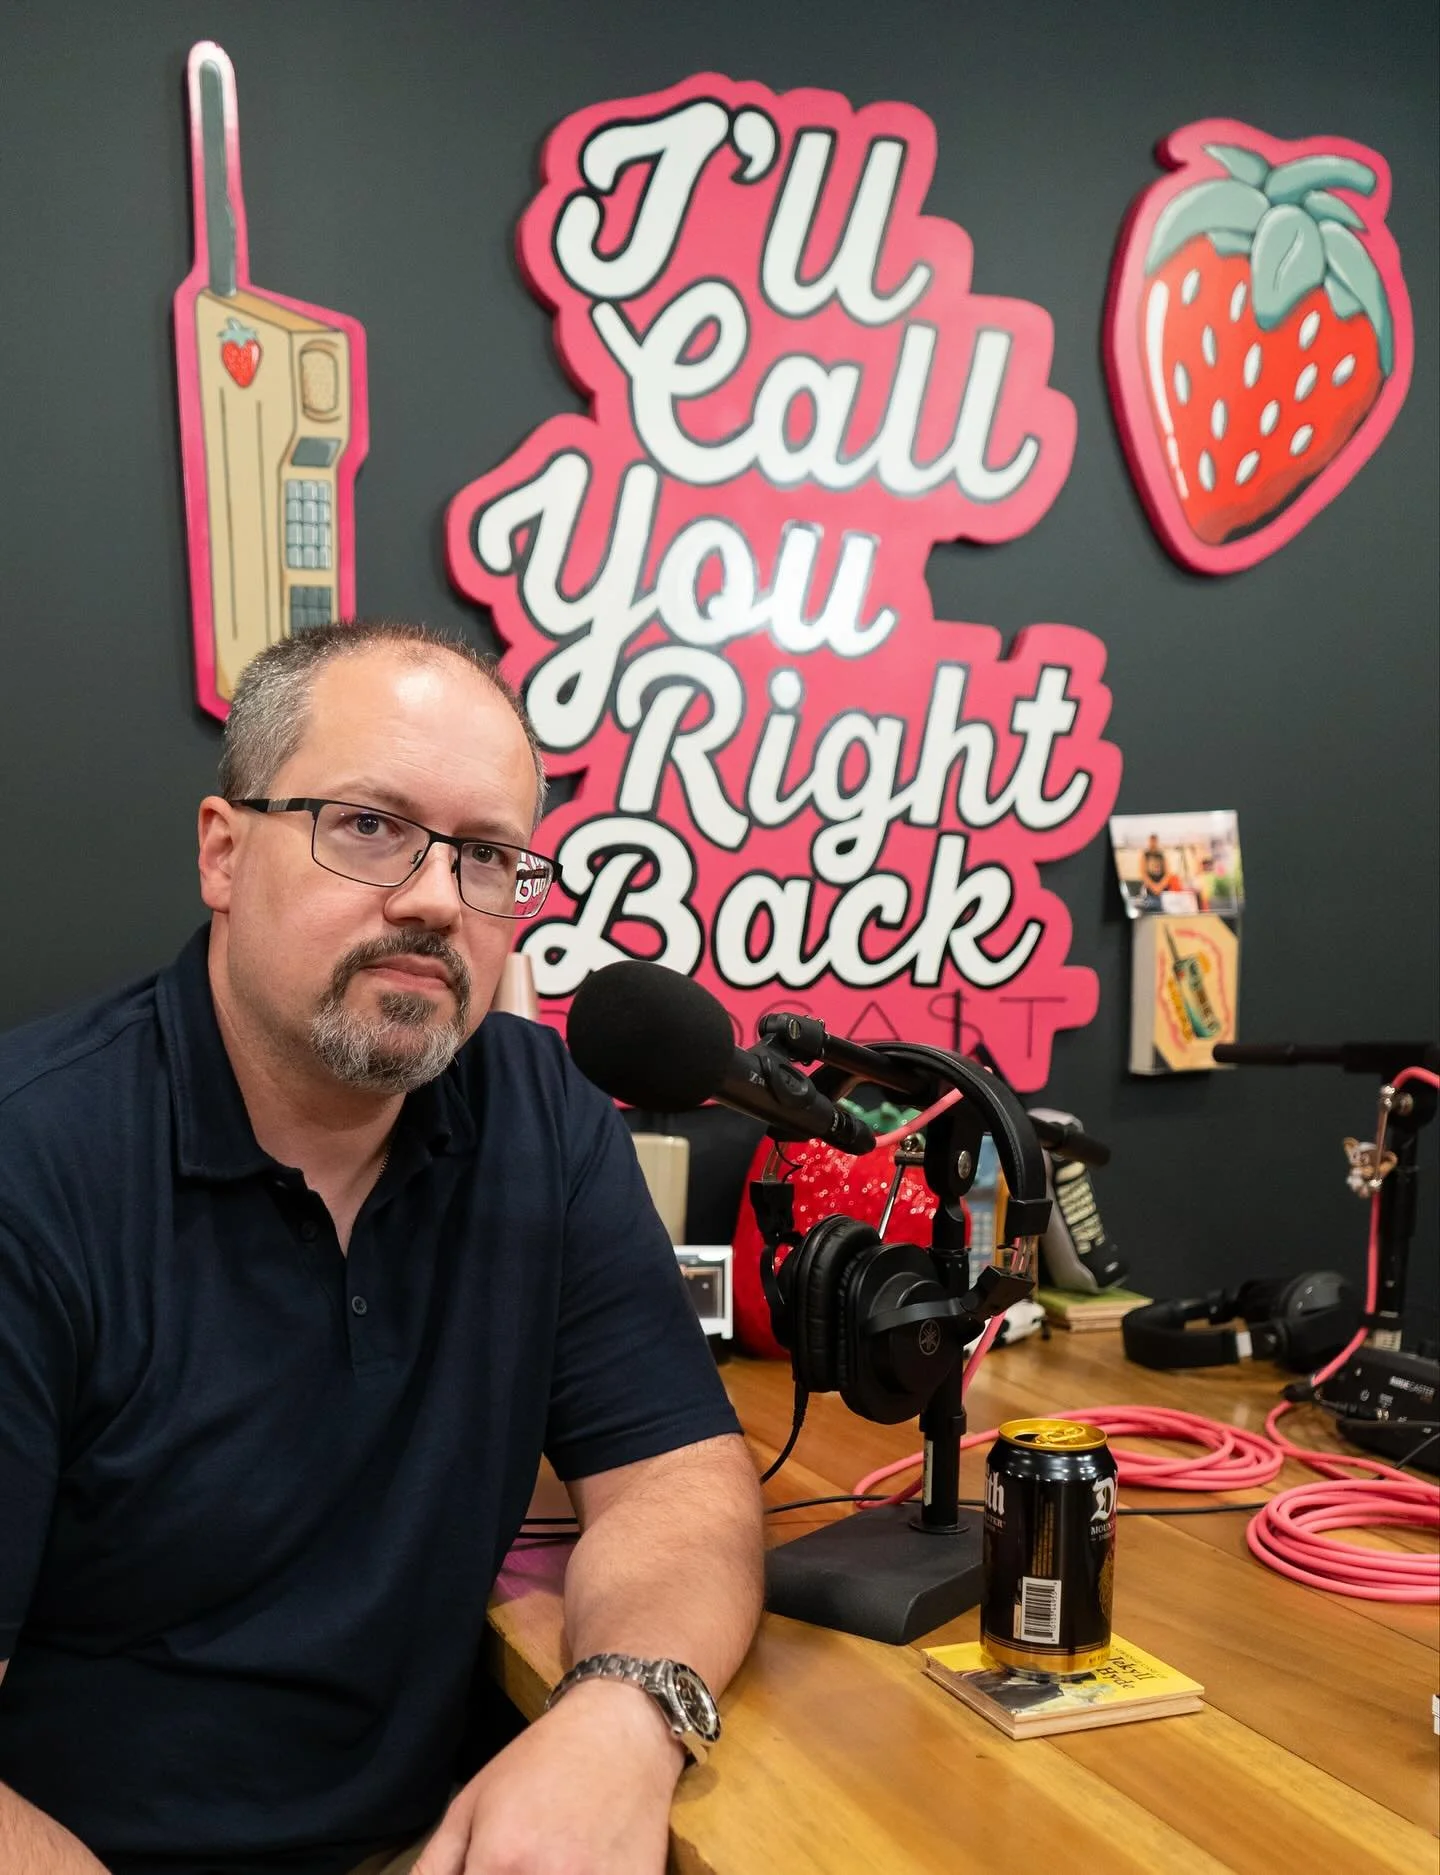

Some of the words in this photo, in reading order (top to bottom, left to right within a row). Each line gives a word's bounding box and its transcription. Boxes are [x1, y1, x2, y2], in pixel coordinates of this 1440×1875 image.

[553, 97, 932, 327] I'll
[592, 278, 1041, 503] Call
[476, 446, 898, 753] You
[615, 645, 1091, 884] Right
[517, 811, 1046, 996] Back
[1090, 1470, 1118, 1522] D
